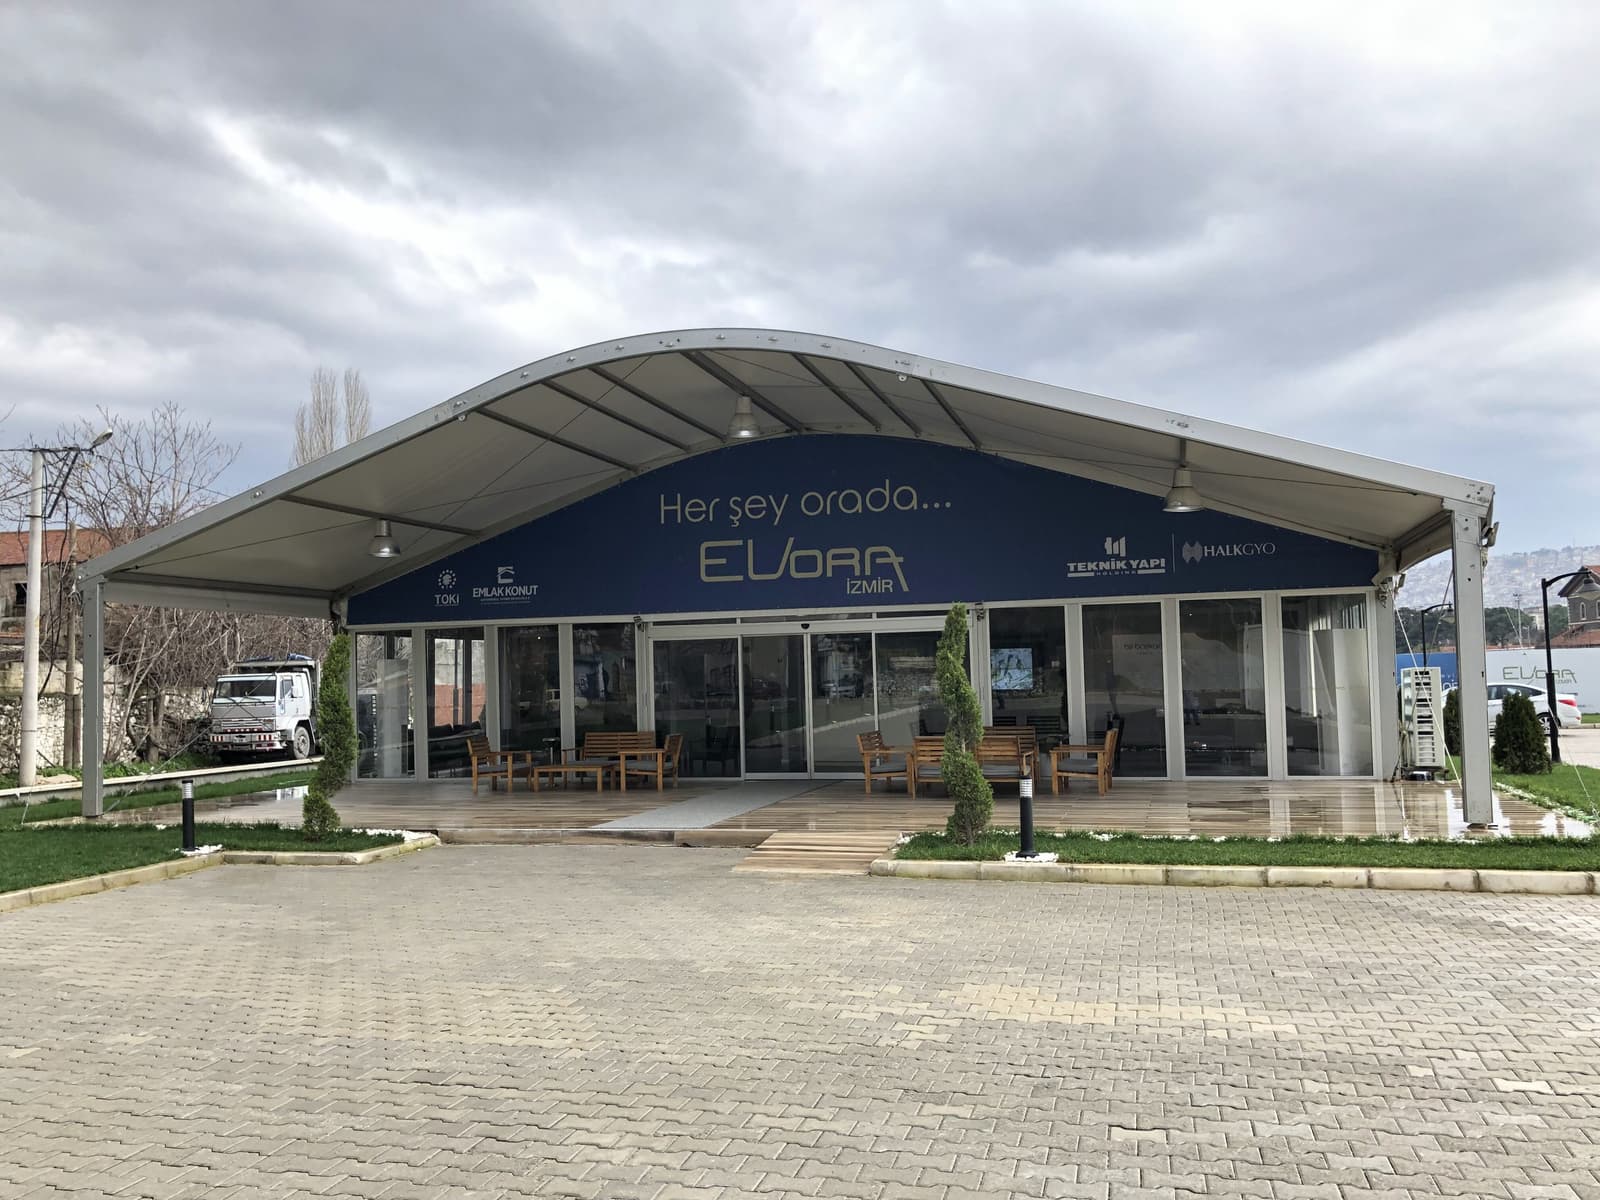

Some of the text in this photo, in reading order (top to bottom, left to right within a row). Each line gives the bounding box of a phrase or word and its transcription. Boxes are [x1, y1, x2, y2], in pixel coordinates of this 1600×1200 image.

[660, 478, 952, 527] Her şey orada...
[1203, 542, 1277, 557] HALKGYO
[1066, 558, 1166, 572] TEKNİK YAPI
[472, 584, 539, 598] EMLAK KONUT
[846, 576, 894, 595] İZMİR
